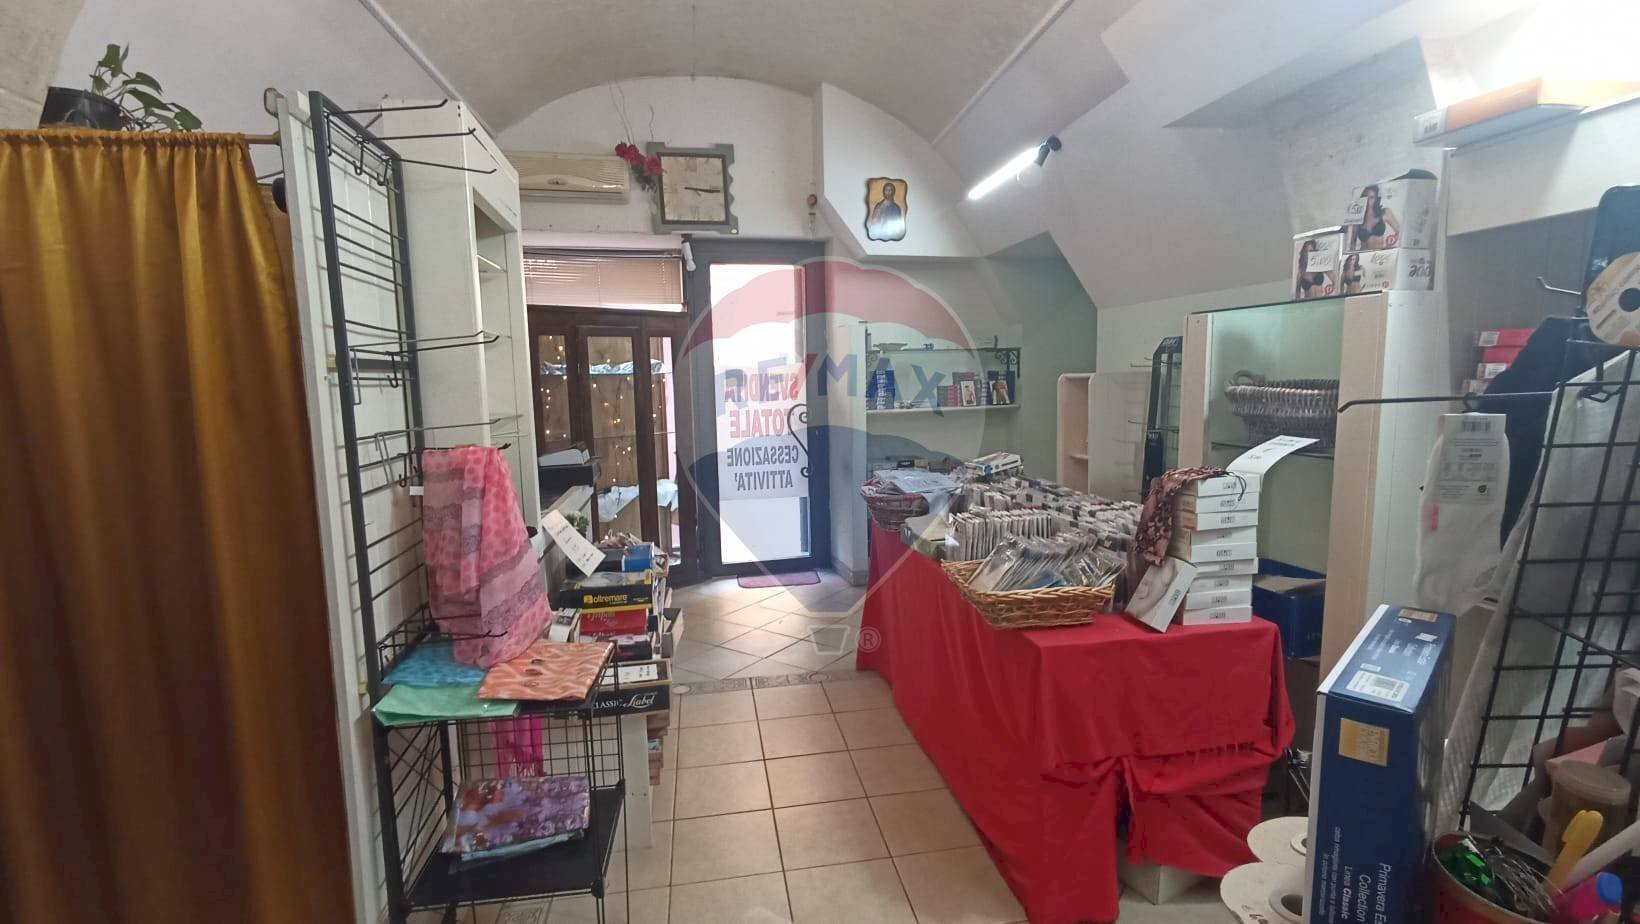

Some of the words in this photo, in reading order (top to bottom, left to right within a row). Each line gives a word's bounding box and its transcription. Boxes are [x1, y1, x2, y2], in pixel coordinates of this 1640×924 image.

[593, 594, 628, 604] oltremare
[1343, 865, 1353, 887] Linea
[1375, 862, 1392, 912] Primavera
[1341, 887, 1352, 919] Classic
[1356, 874, 1372, 922] Collection
